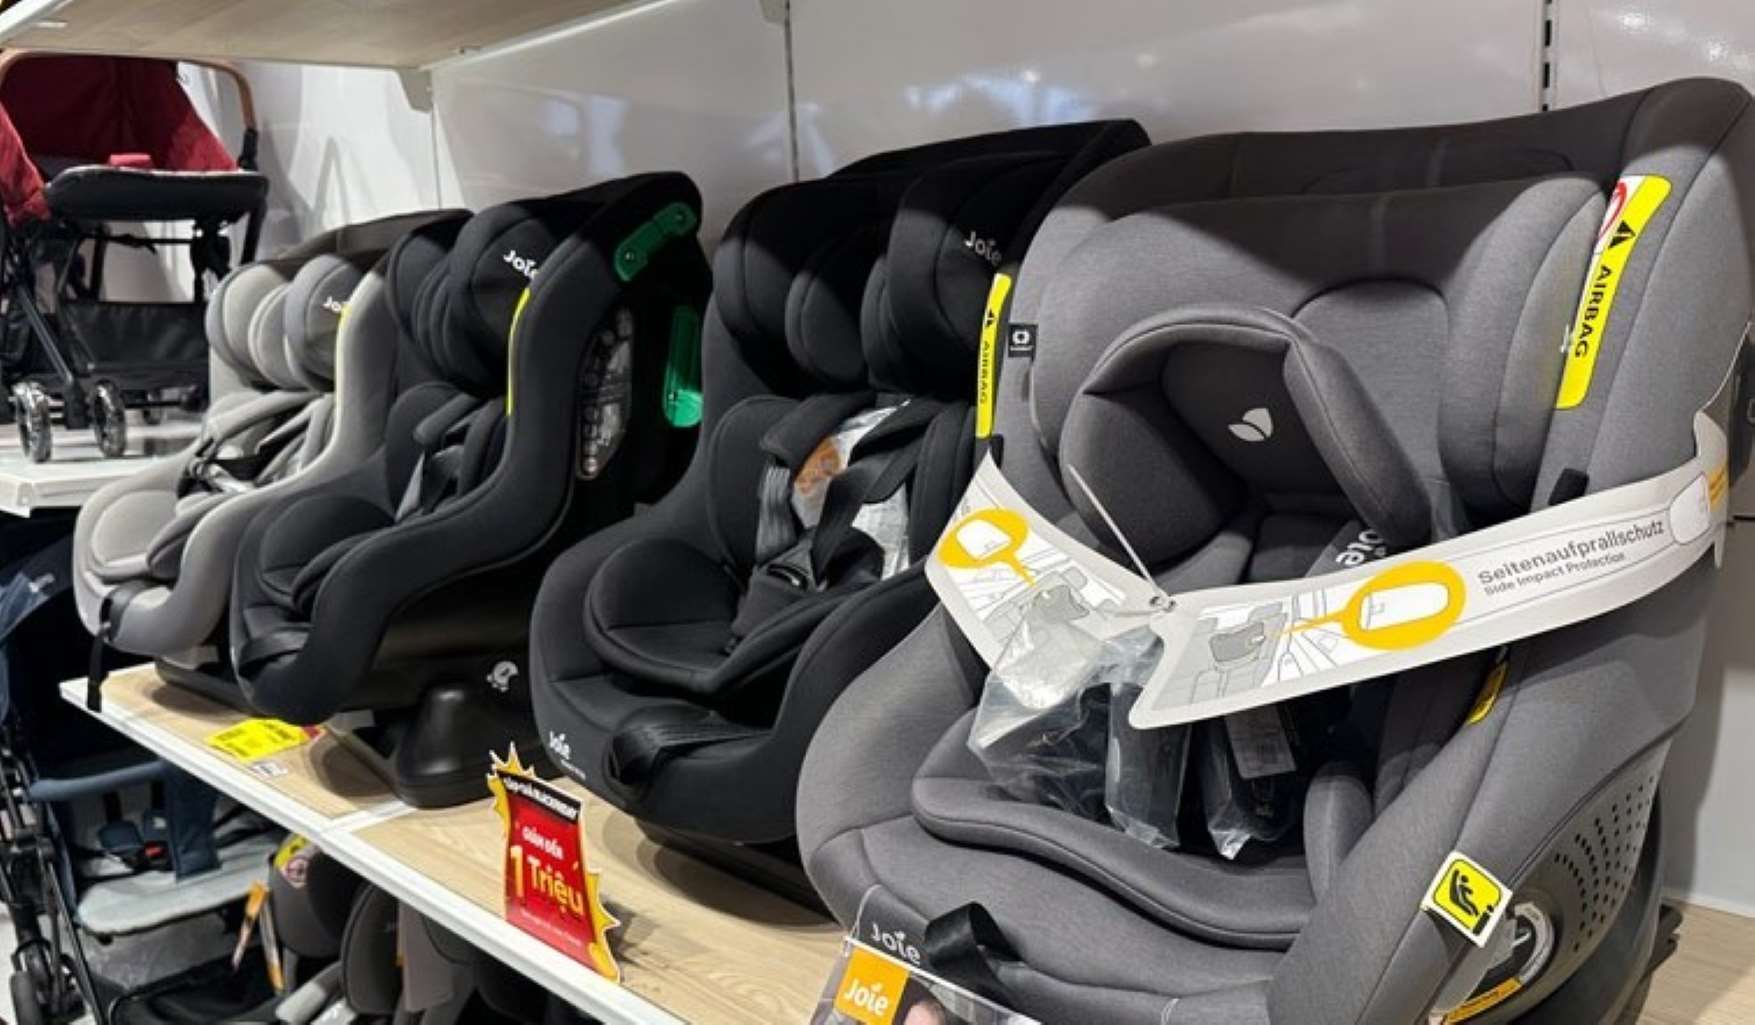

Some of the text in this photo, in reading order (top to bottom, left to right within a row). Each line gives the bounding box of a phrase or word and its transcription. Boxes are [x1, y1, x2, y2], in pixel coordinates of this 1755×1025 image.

[963, 231, 1002, 265] Joie
[1574, 265, 1612, 358] AIRBAG
[1477, 519, 1665, 585] Seitenaufprallschutz
[1516, 566, 1566, 588] Impact
[1566, 552, 1626, 576] Protection
[510, 845, 585, 917] 1 Triệu
[871, 922, 921, 966] Joie
[843, 977, 889, 1017] Joie
